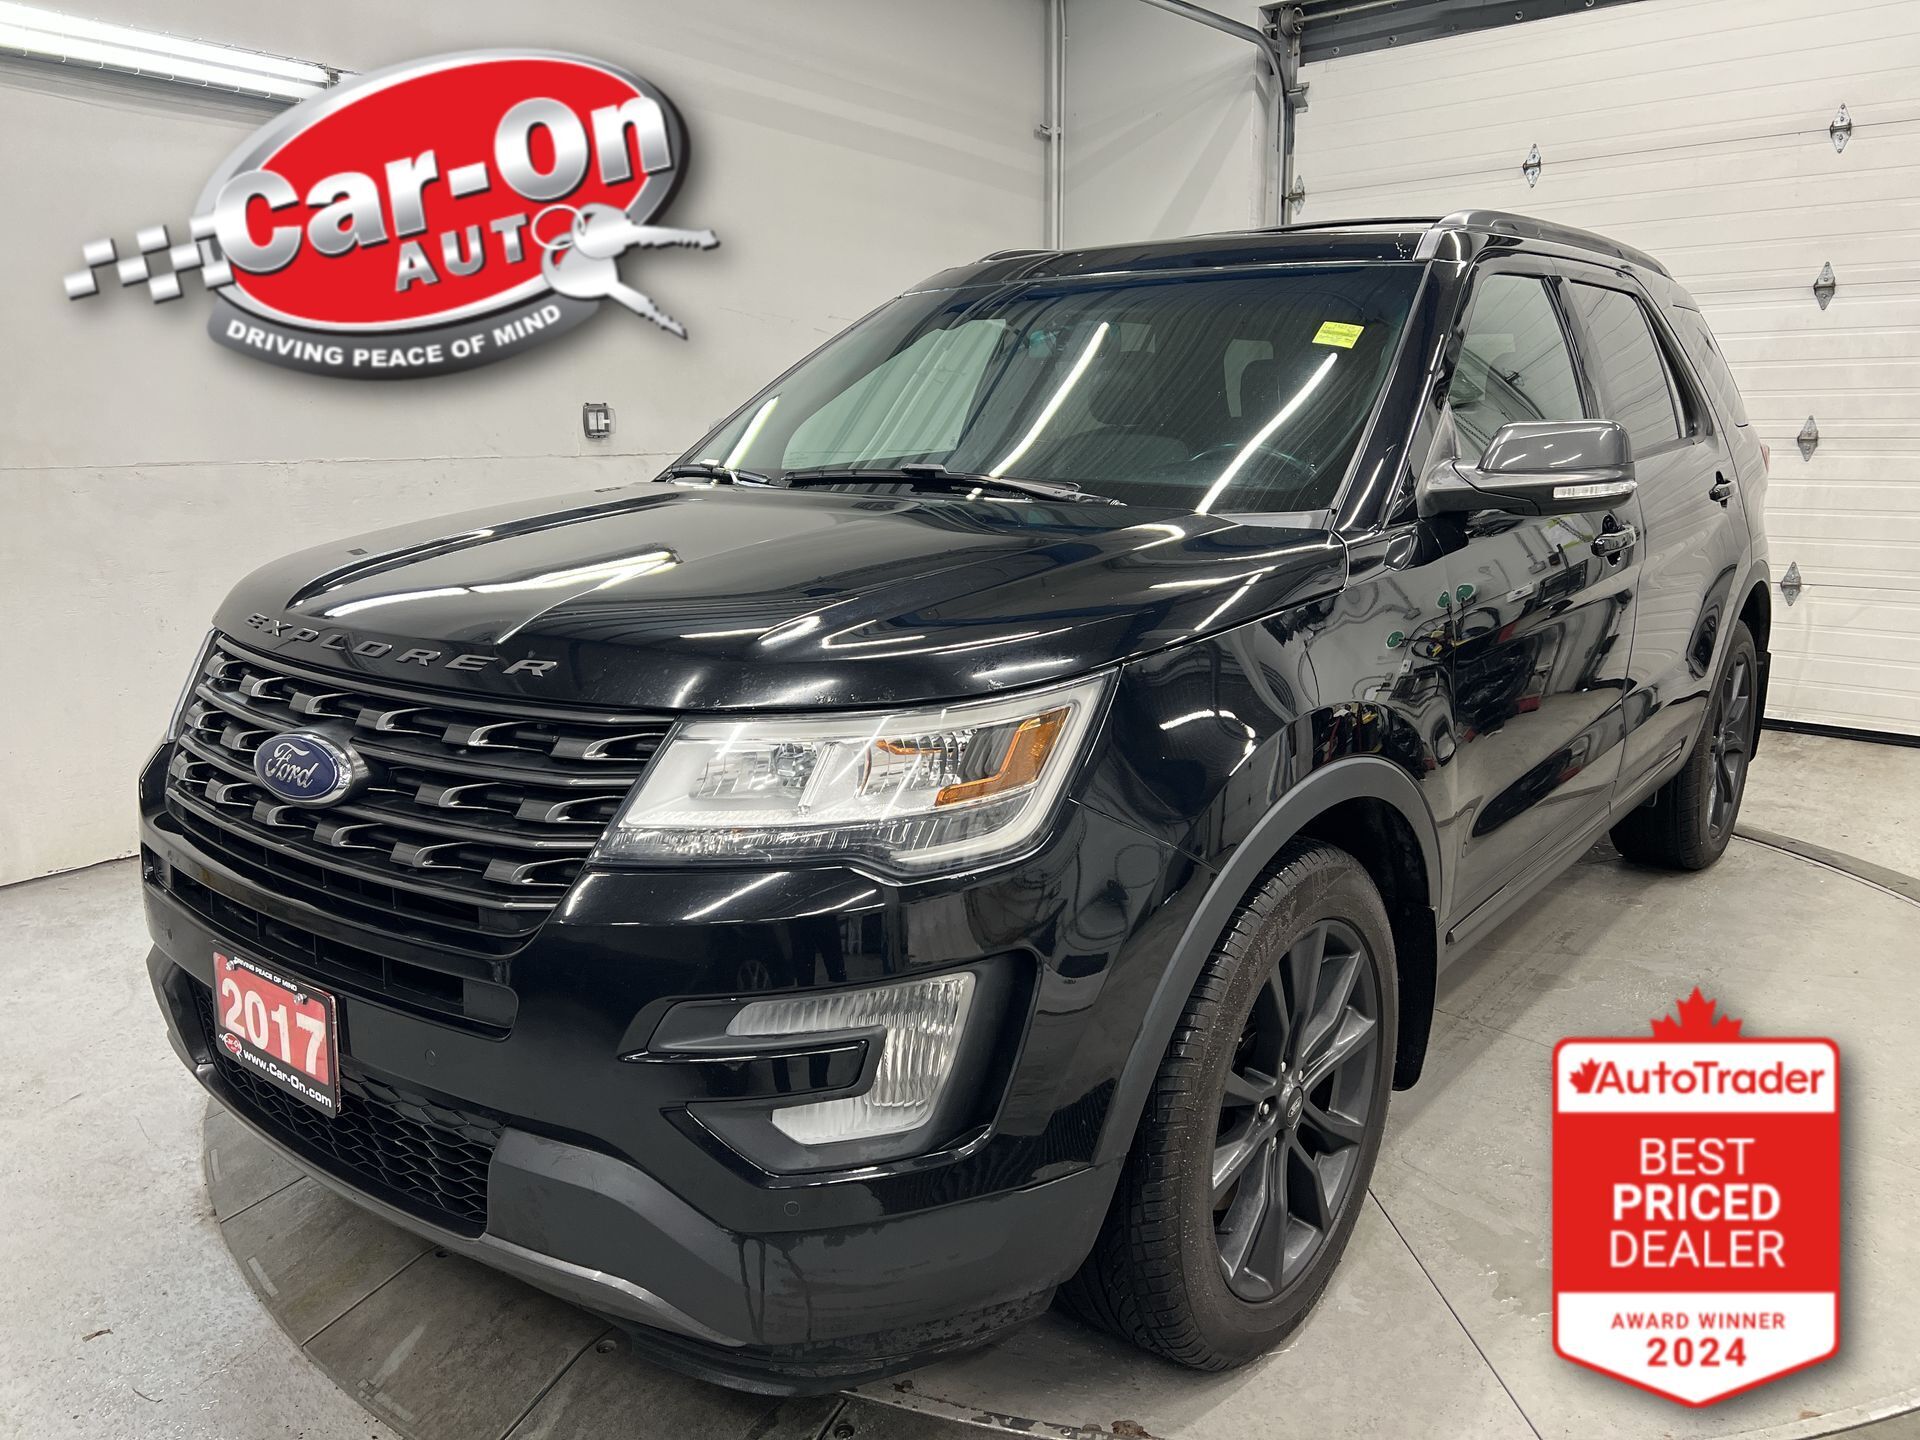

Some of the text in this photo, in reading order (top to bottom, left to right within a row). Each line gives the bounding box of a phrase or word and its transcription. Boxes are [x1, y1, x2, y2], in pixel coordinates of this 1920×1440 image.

[244, 612, 558, 677] EXPLORER
[265, 743, 319, 789] Ford
[233, 956, 298, 992] DRIVING PEACE OF MIND
[221, 977, 326, 1076] 2017
[242, 1049, 333, 1108] www.Car-On.com
